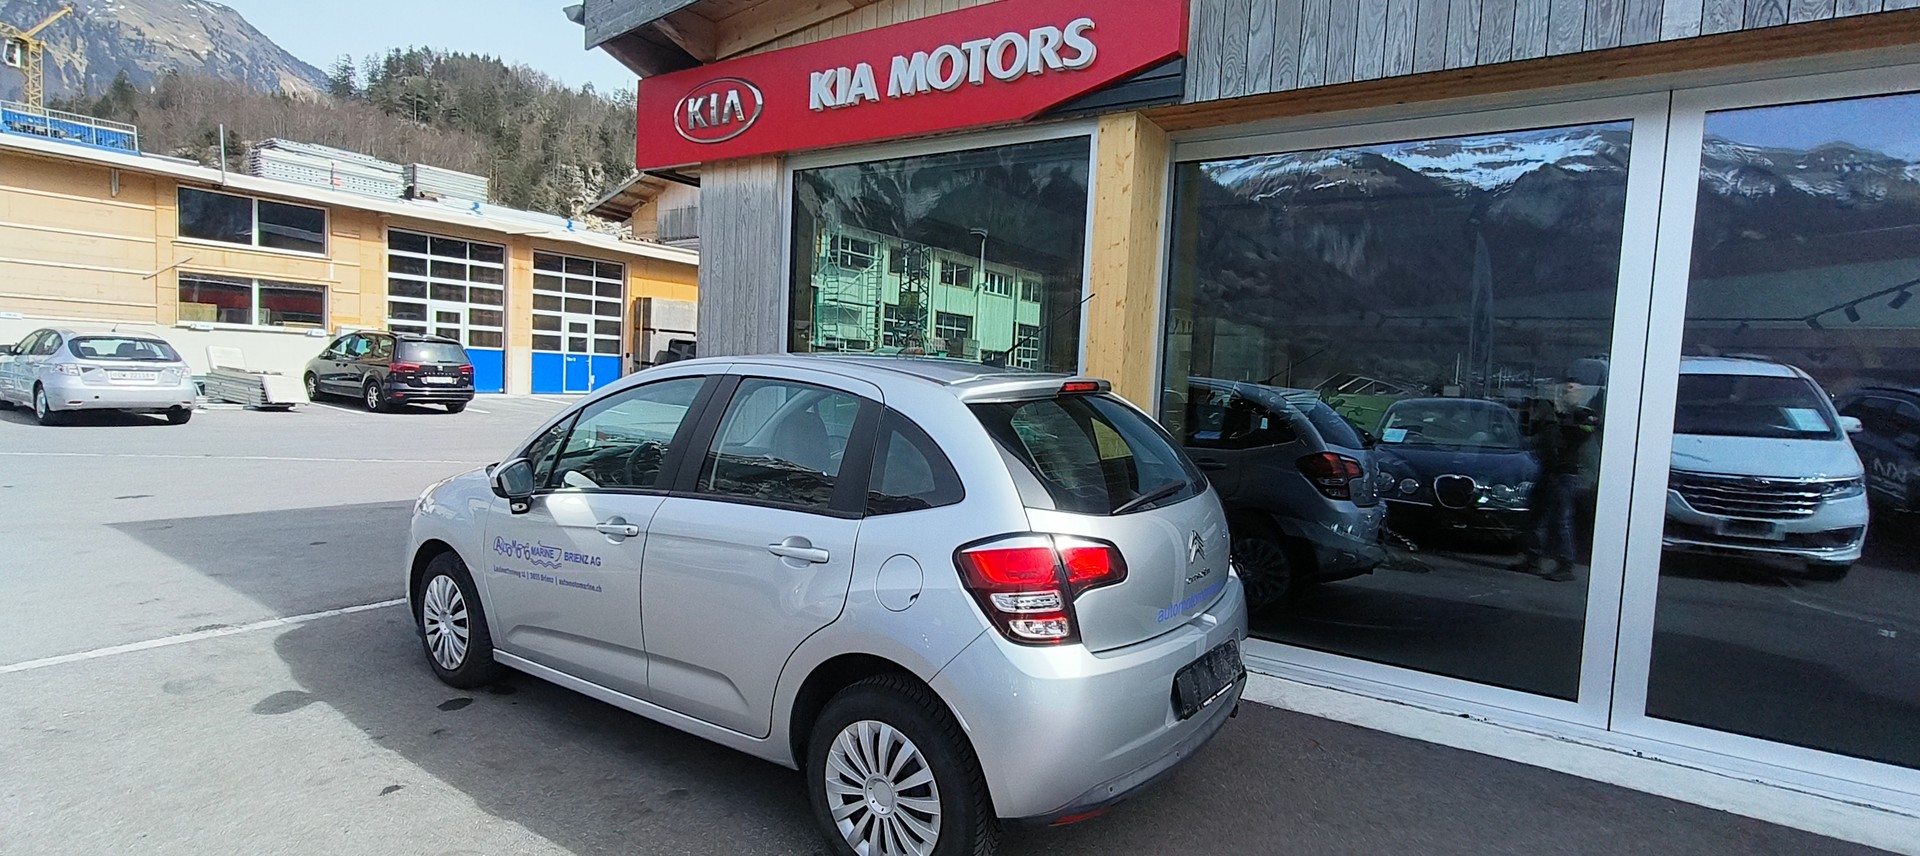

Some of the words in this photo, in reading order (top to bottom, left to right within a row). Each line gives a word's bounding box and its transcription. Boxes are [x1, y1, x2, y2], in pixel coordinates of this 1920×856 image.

[809, 62, 880, 111] KIA
[887, 18, 1098, 97] MOTORS
[687, 89, 746, 130] KIA
[531, 546, 554, 559] MARINE
[564, 551, 589, 565] BRIENZ
[590, 556, 602, 567] AG
